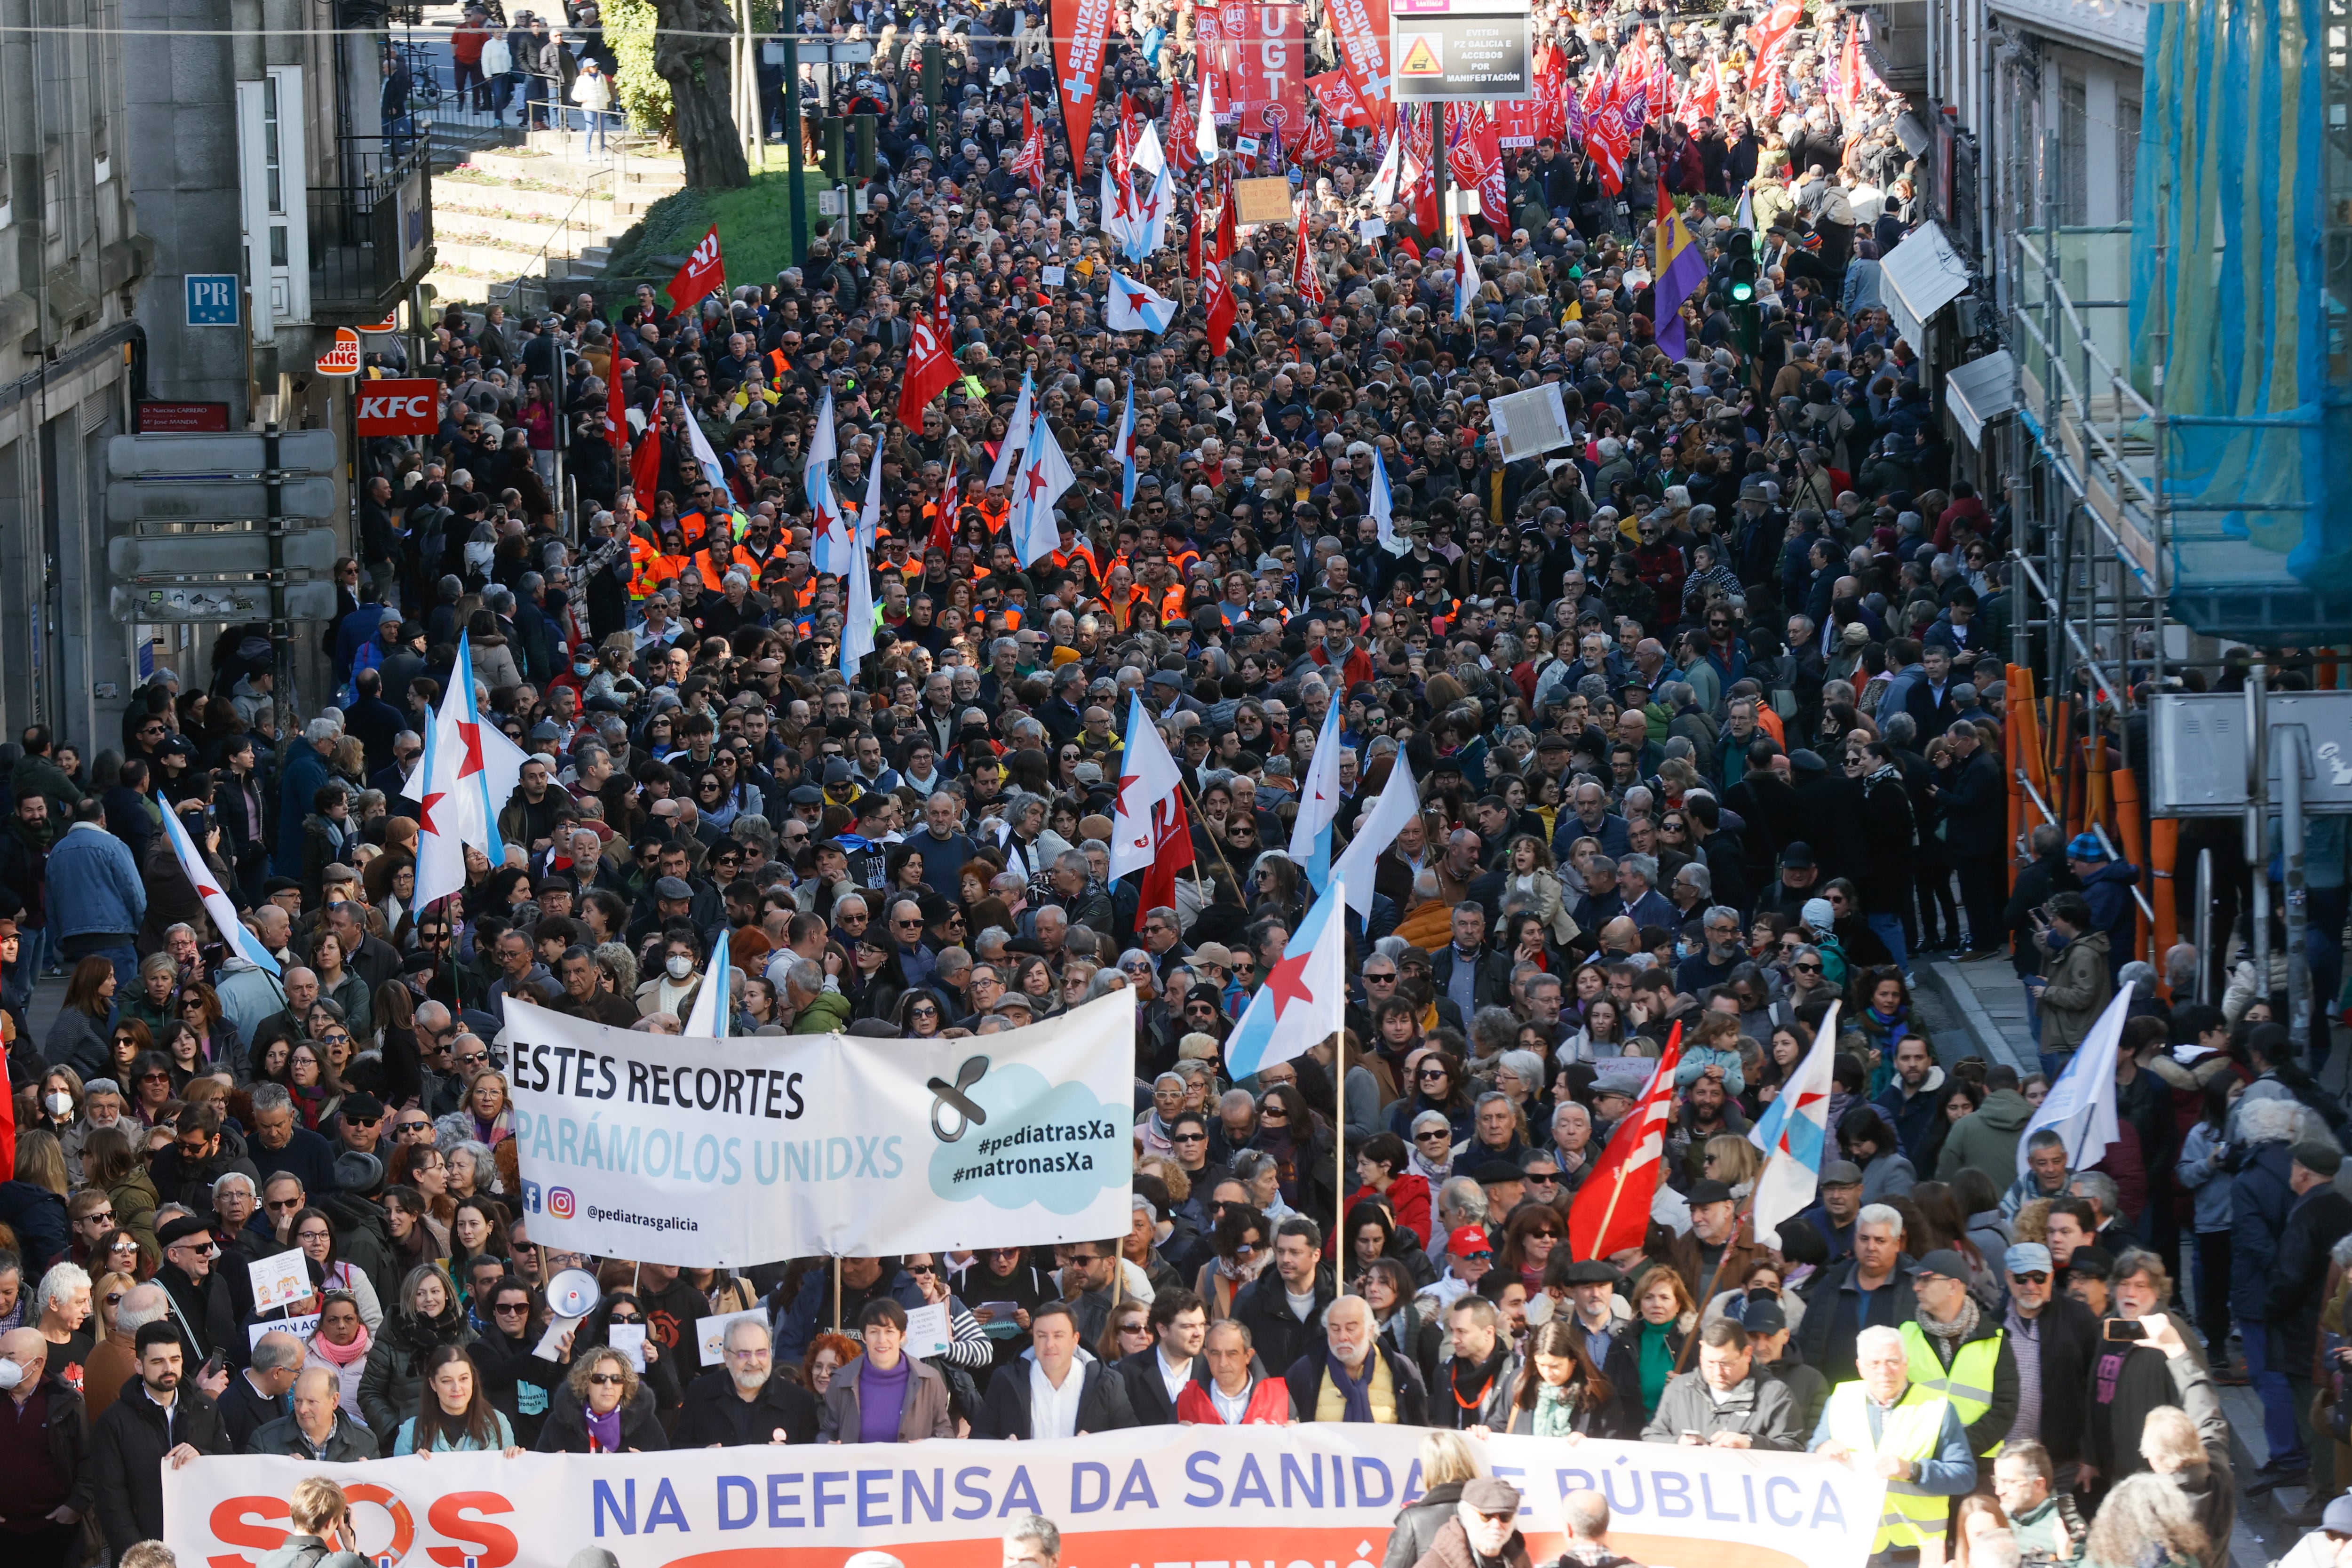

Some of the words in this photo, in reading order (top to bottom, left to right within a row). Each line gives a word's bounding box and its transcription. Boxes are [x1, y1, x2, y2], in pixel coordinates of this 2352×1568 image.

[1083, 0, 1109, 73] PÚBLICO
[1261, 7, 1287, 100] UGT
[1446, 73, 1520, 82] MANIFESTACIÓN
[1504, 137, 1532, 146] LUGO
[193, 282, 230, 306] PR
[334, 343, 357, 351] GER
[358, 396, 429, 419] KFC
[513, 1042, 617, 1100] ESTES
[627, 1060, 804, 1120] RECORTES
[515, 1109, 742, 1186] PARÁMOLOS
[754, 1135, 904, 1186] UNIDXS
[978, 1120, 1115, 1156] #pediatrasXa
[952, 1152, 1093, 1184] #matronasXa
[588, 1205, 698, 1232] @pediatrasgalicia
[593, 1477, 691, 1537] NA
[717, 1465, 1043, 1531] DEFENSA
[1070, 1457, 1159, 1513] DA
[1184, 1450, 1533, 1516] SANIDAE
[1556, 1454, 1848, 1534] PÚBLICA
